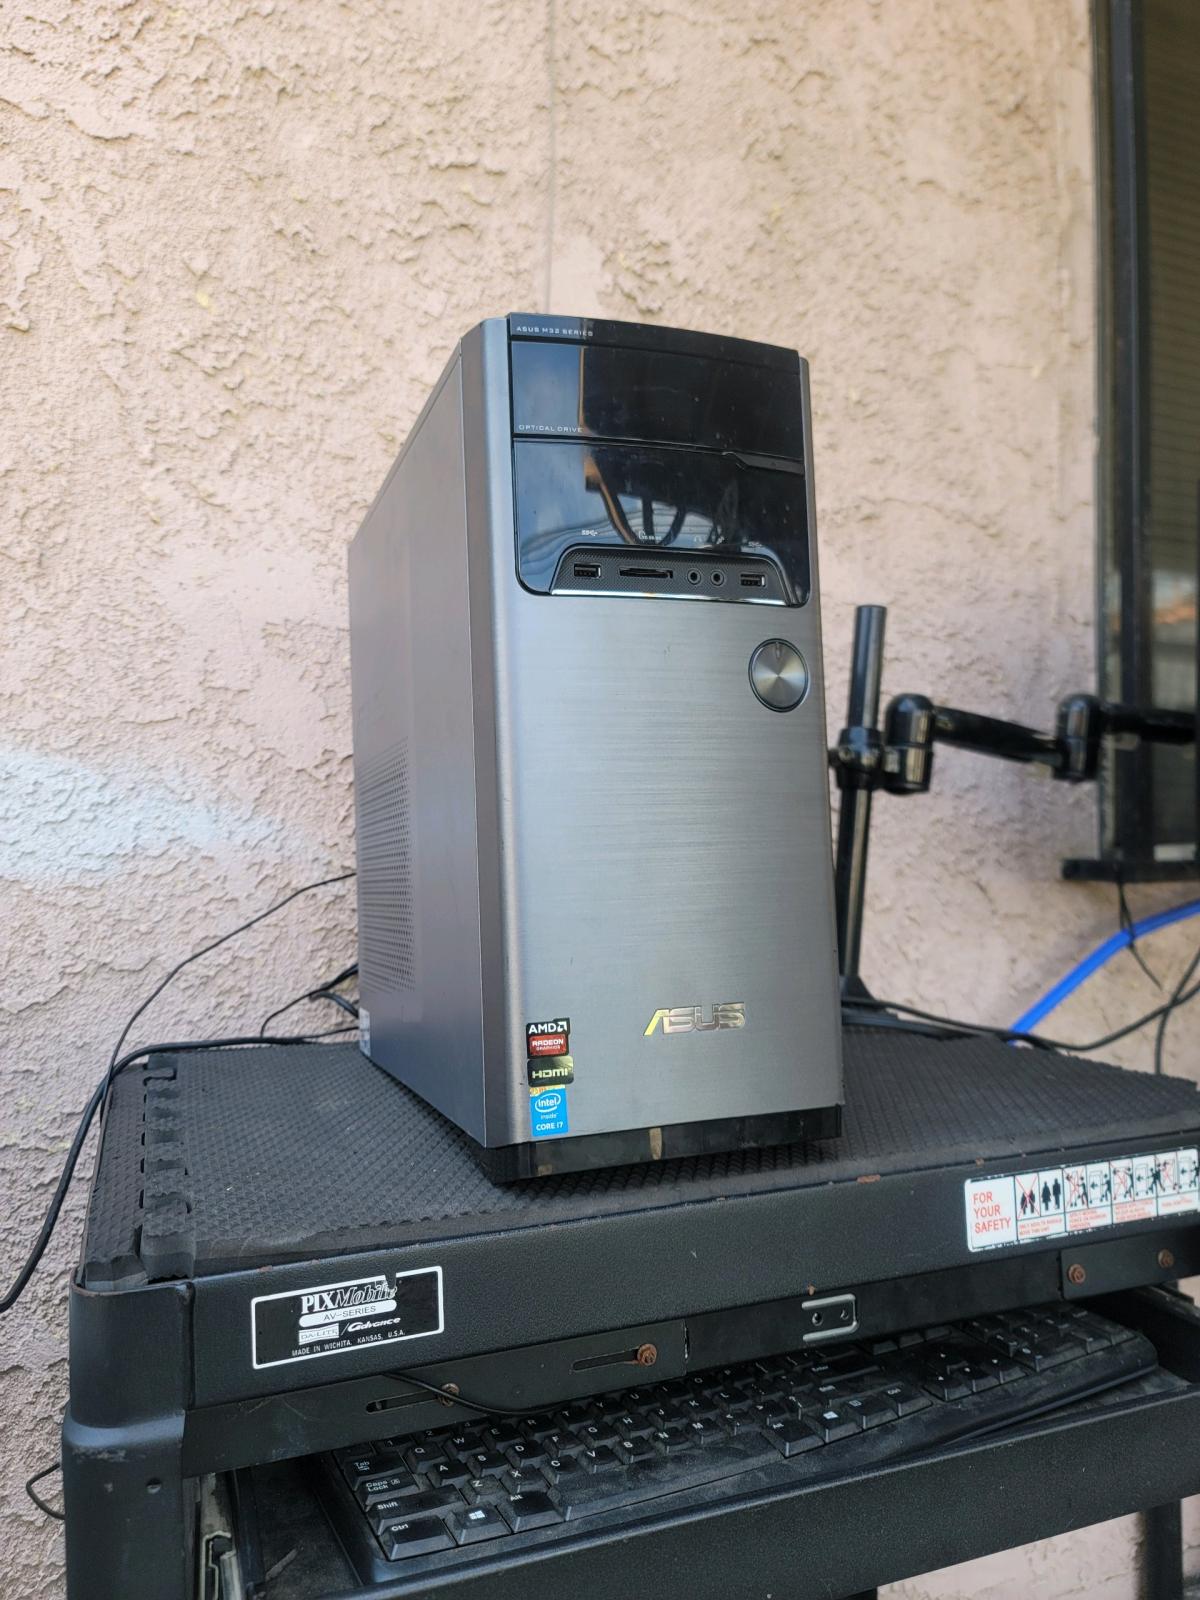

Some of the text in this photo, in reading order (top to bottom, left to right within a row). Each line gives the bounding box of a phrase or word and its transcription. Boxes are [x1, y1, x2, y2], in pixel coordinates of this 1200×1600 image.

[562, 329, 594, 337] SERIES
[518, 424, 555, 432] OPTICAL
[643, 1002, 745, 1036] ASUS
[528, 1022, 557, 1034] AMD
[532, 1038, 564, 1047] RADEON
[536, 1122, 556, 1131] CORE
[973, 1191, 993, 1205] FOR
[973, 1204, 1001, 1219] YOUR
[975, 1216, 1011, 1234] SAFETY
[292, 1348, 311, 1357] MADE
[388, 1329, 406, 1338] U.S.A.
[439, 1464, 449, 1472] A
[511, 1470, 522, 1478] X
[366, 1480, 388, 1488] Caps
[367, 1484, 389, 1492] Lock
[377, 1501, 399, 1510] Shift
[391, 1523, 409, 1532] Ctrl
